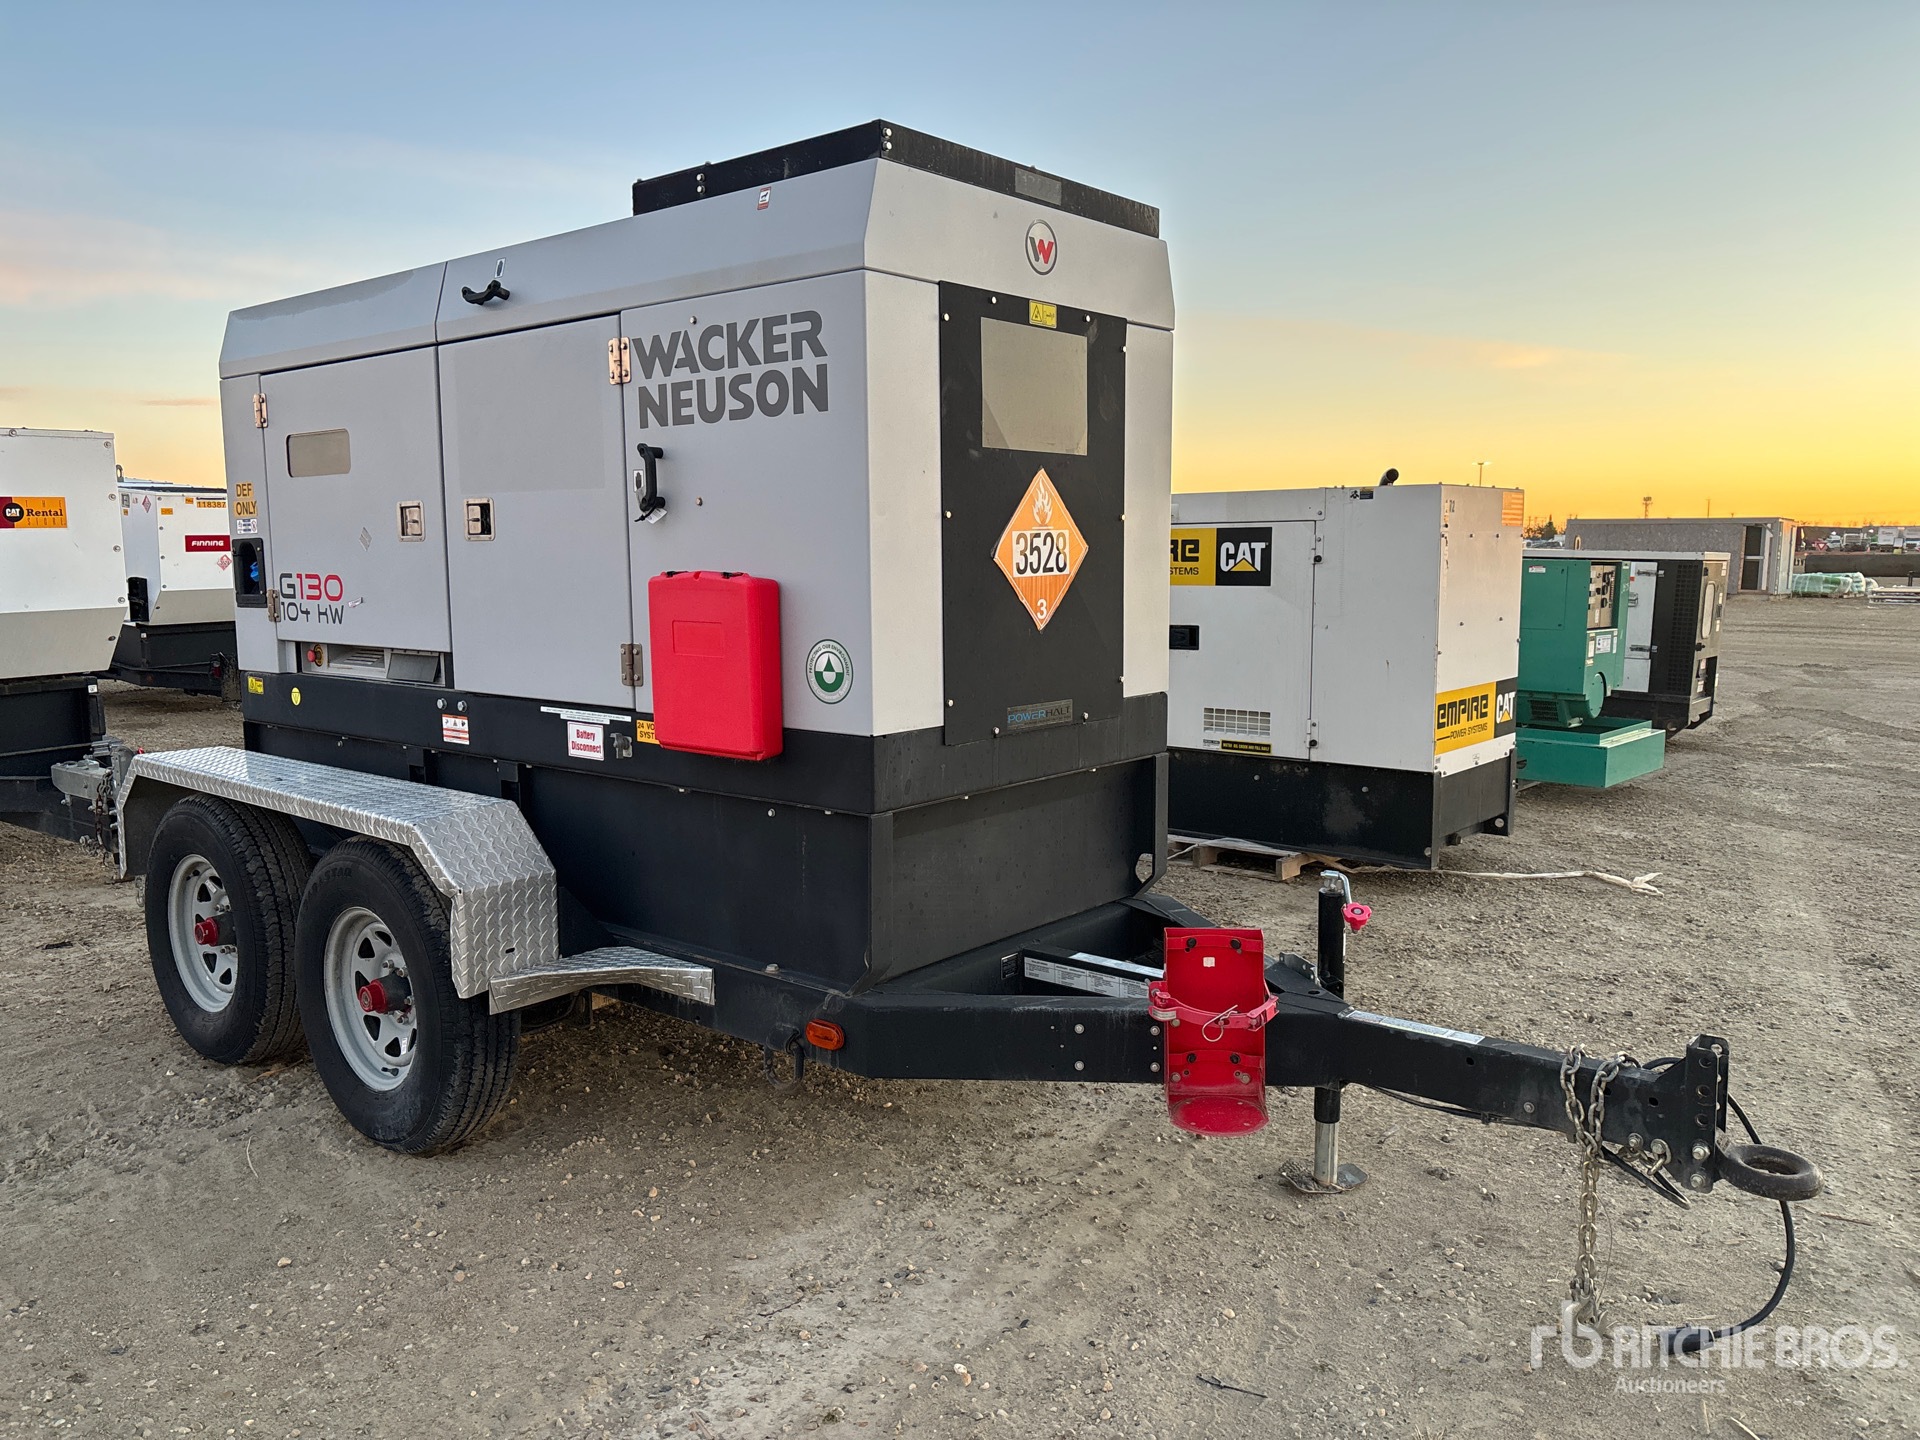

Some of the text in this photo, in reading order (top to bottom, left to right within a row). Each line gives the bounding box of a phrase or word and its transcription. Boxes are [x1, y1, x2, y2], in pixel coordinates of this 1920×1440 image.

[632, 310, 828, 380] WACKER
[638, 363, 829, 429] NEUSON
[236, 484, 252, 497] DEF
[5, 508, 20, 517] CAT
[26, 509, 63, 517] Rental
[236, 501, 257, 515] ONLY
[1016, 532, 1068, 575] 3528
[1220, 541, 1266, 572] CAT
[280, 573, 343, 602] G130
[281, 602, 310, 623] 104
[1037, 599, 1047, 619] 3
[808, 646, 822, 674] PROTECTING
[831, 644, 850, 676] ENVIRONMENT
[1007, 706, 1070, 724] POWERHALT
[1437, 694, 1488, 730] EMPIRE
[1496, 691, 1516, 724] CAT
[576, 729, 596, 741] Battery
[637, 721, 655, 731] 24 VO
[640, 730, 654, 740] SYST
[1450, 722, 1488, 740] POWER SYSTEMS
[571, 741, 602, 754] Disconnect
